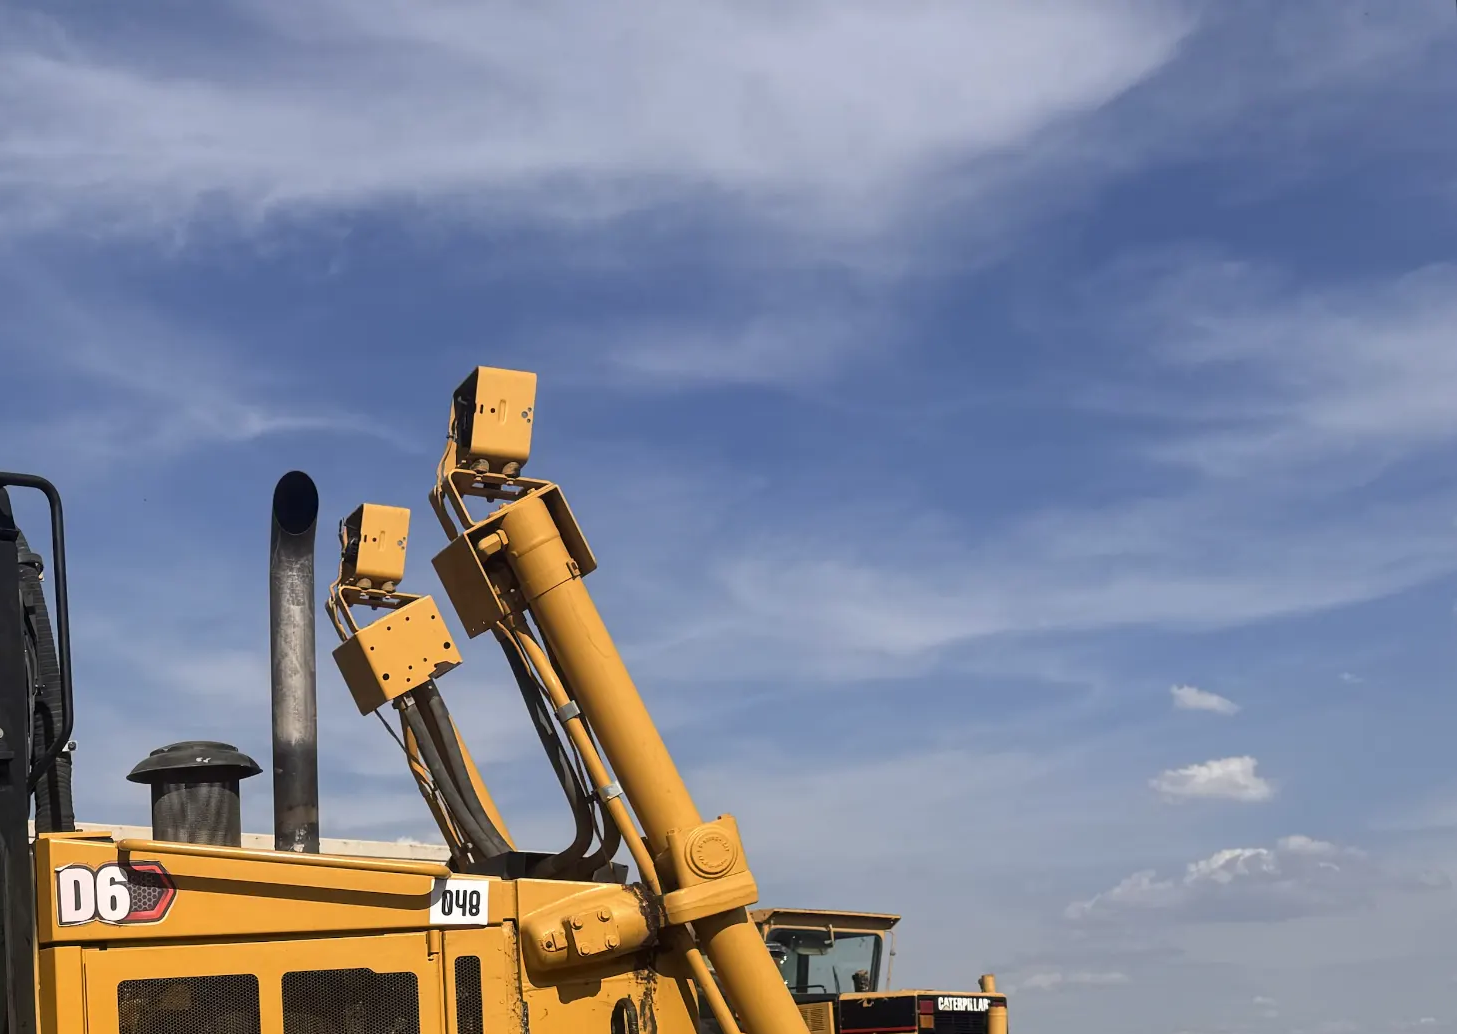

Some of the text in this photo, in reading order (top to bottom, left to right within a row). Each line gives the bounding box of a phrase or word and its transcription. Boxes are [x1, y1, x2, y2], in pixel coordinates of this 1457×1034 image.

[59, 866, 131, 923] D6
[441, 890, 480, 917] 048
[937, 996, 990, 1012] CATERPILLAR
